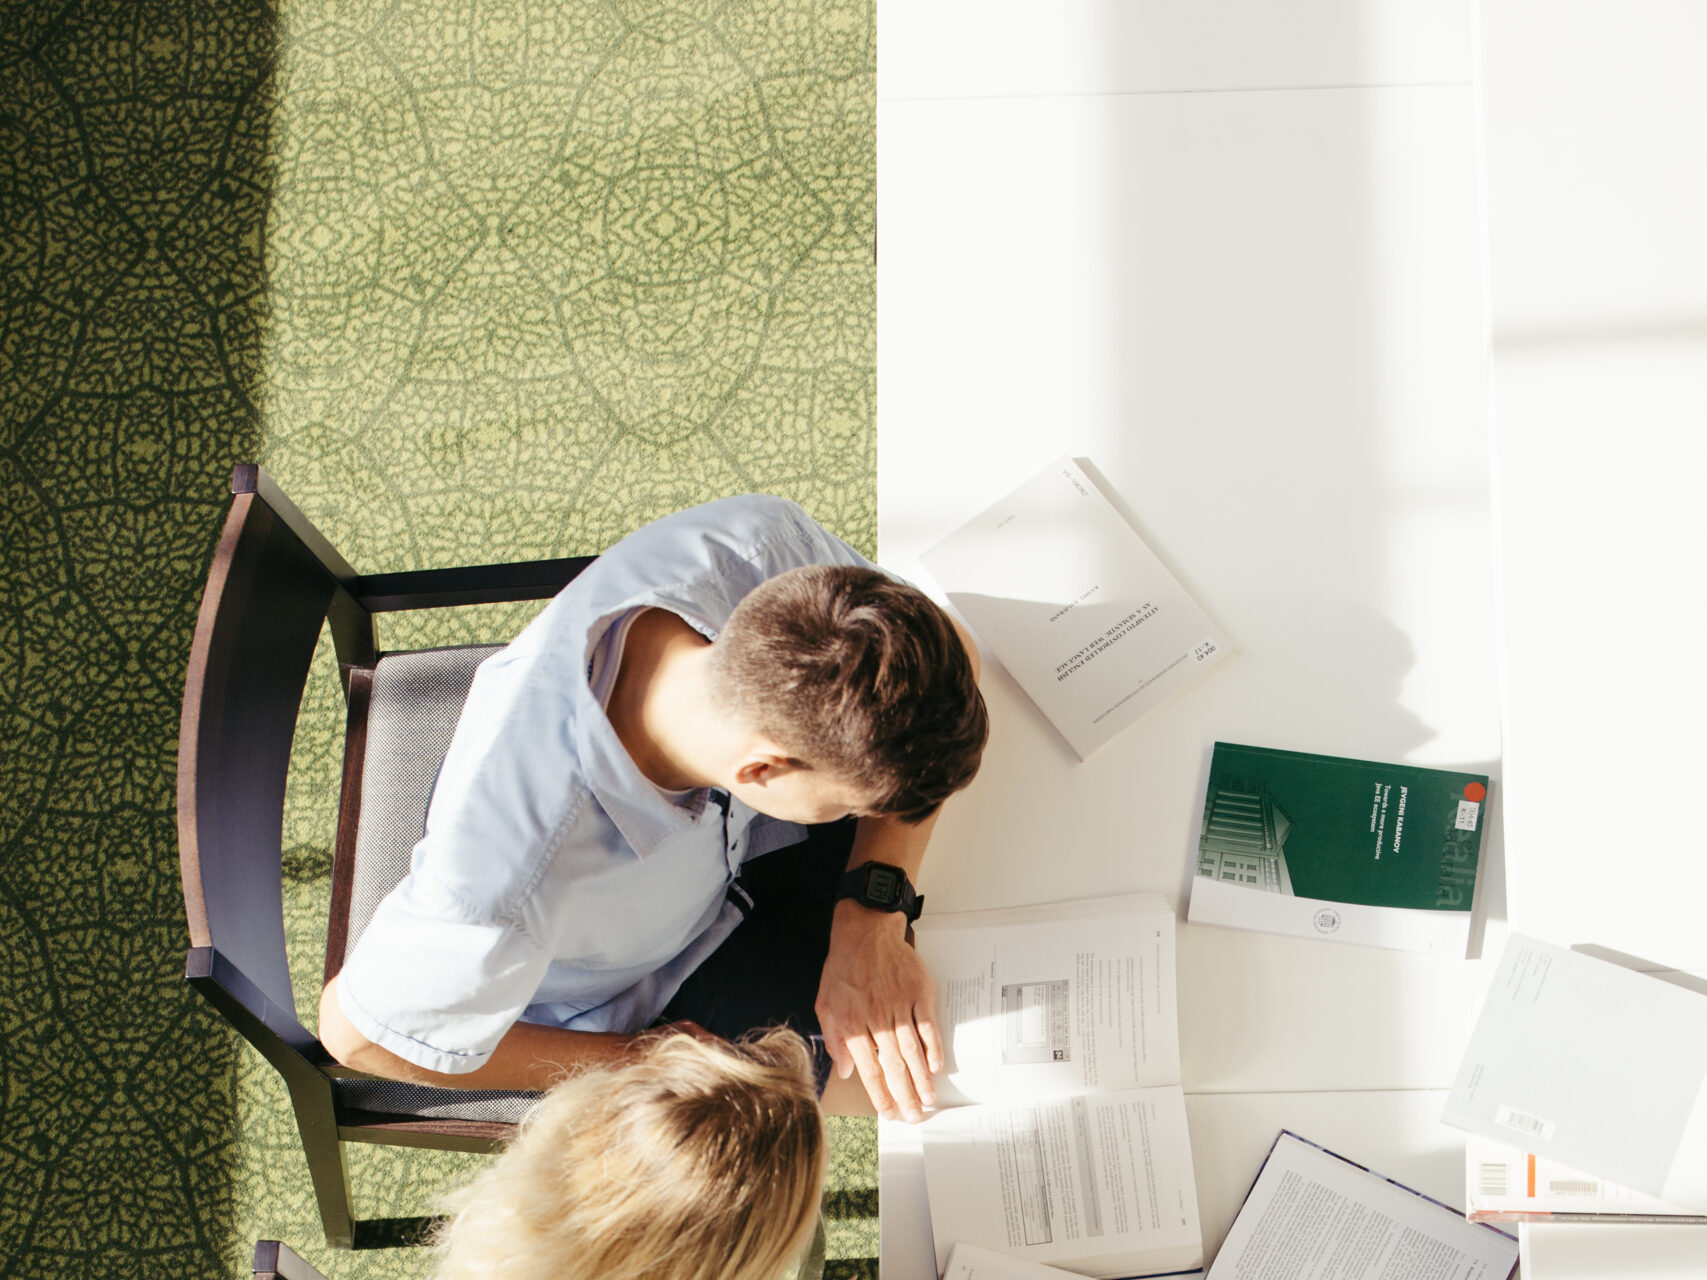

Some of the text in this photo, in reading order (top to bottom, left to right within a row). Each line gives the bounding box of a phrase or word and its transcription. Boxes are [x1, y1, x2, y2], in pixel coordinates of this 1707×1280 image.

[1141, 601, 1151, 610] AS
[1105, 613, 1135, 636] SEMANTIC
[1056, 606, 1158, 682] ATTEMPTO CONTROLLED ENGLISH
[1089, 636, 1103, 648] WEB
[1055, 647, 1088, 673] LANGUAGE
[1373, 782, 1382, 794] Java
[1381, 784, 1391, 808] Towards
[1368, 803, 1379, 832] ecosystem
[1392, 785, 1408, 853] JEVGENI KABANOV
[1373, 829, 1384, 860] productive
